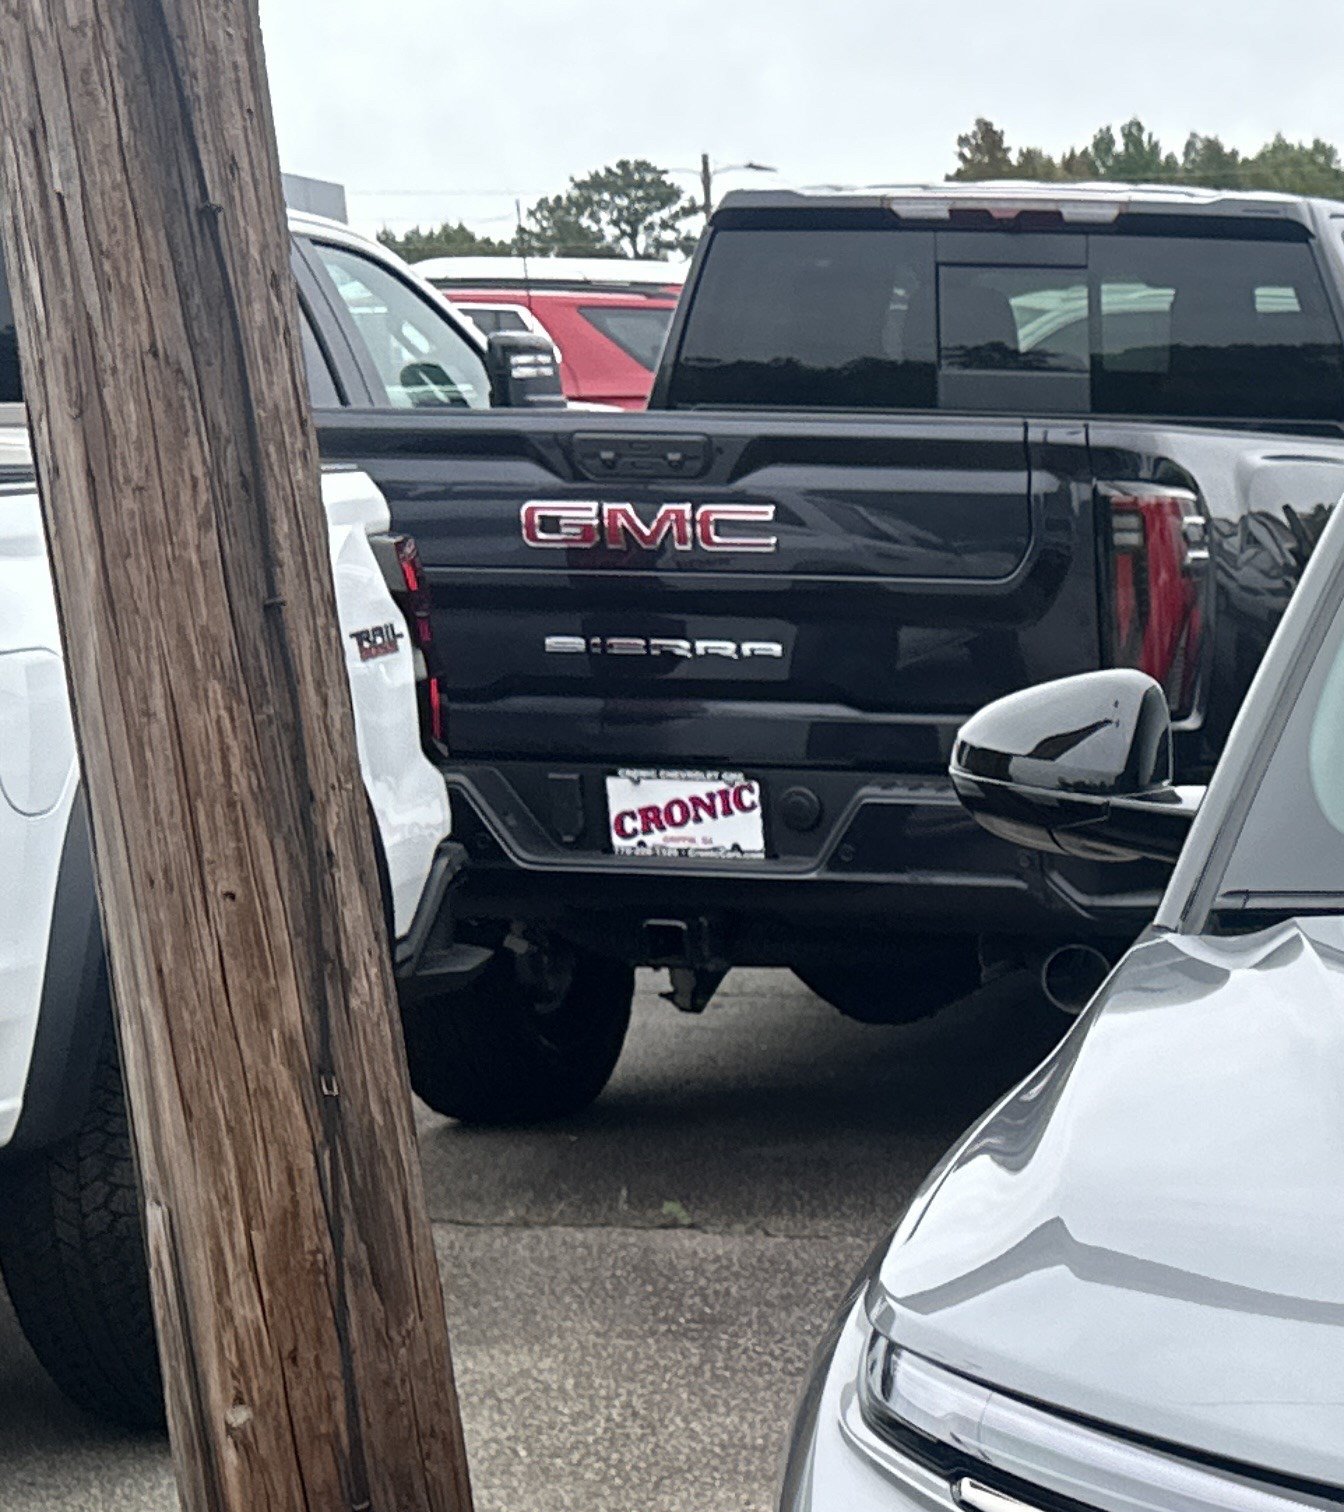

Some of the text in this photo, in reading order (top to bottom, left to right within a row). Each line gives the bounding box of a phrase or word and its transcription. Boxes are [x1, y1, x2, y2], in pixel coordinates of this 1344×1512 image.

[520, 500, 777, 552] GMC
[349, 622, 404, 649] TRAIL
[544, 635, 783, 660] SIERRA
[613, 783, 758, 839] CRONIC
